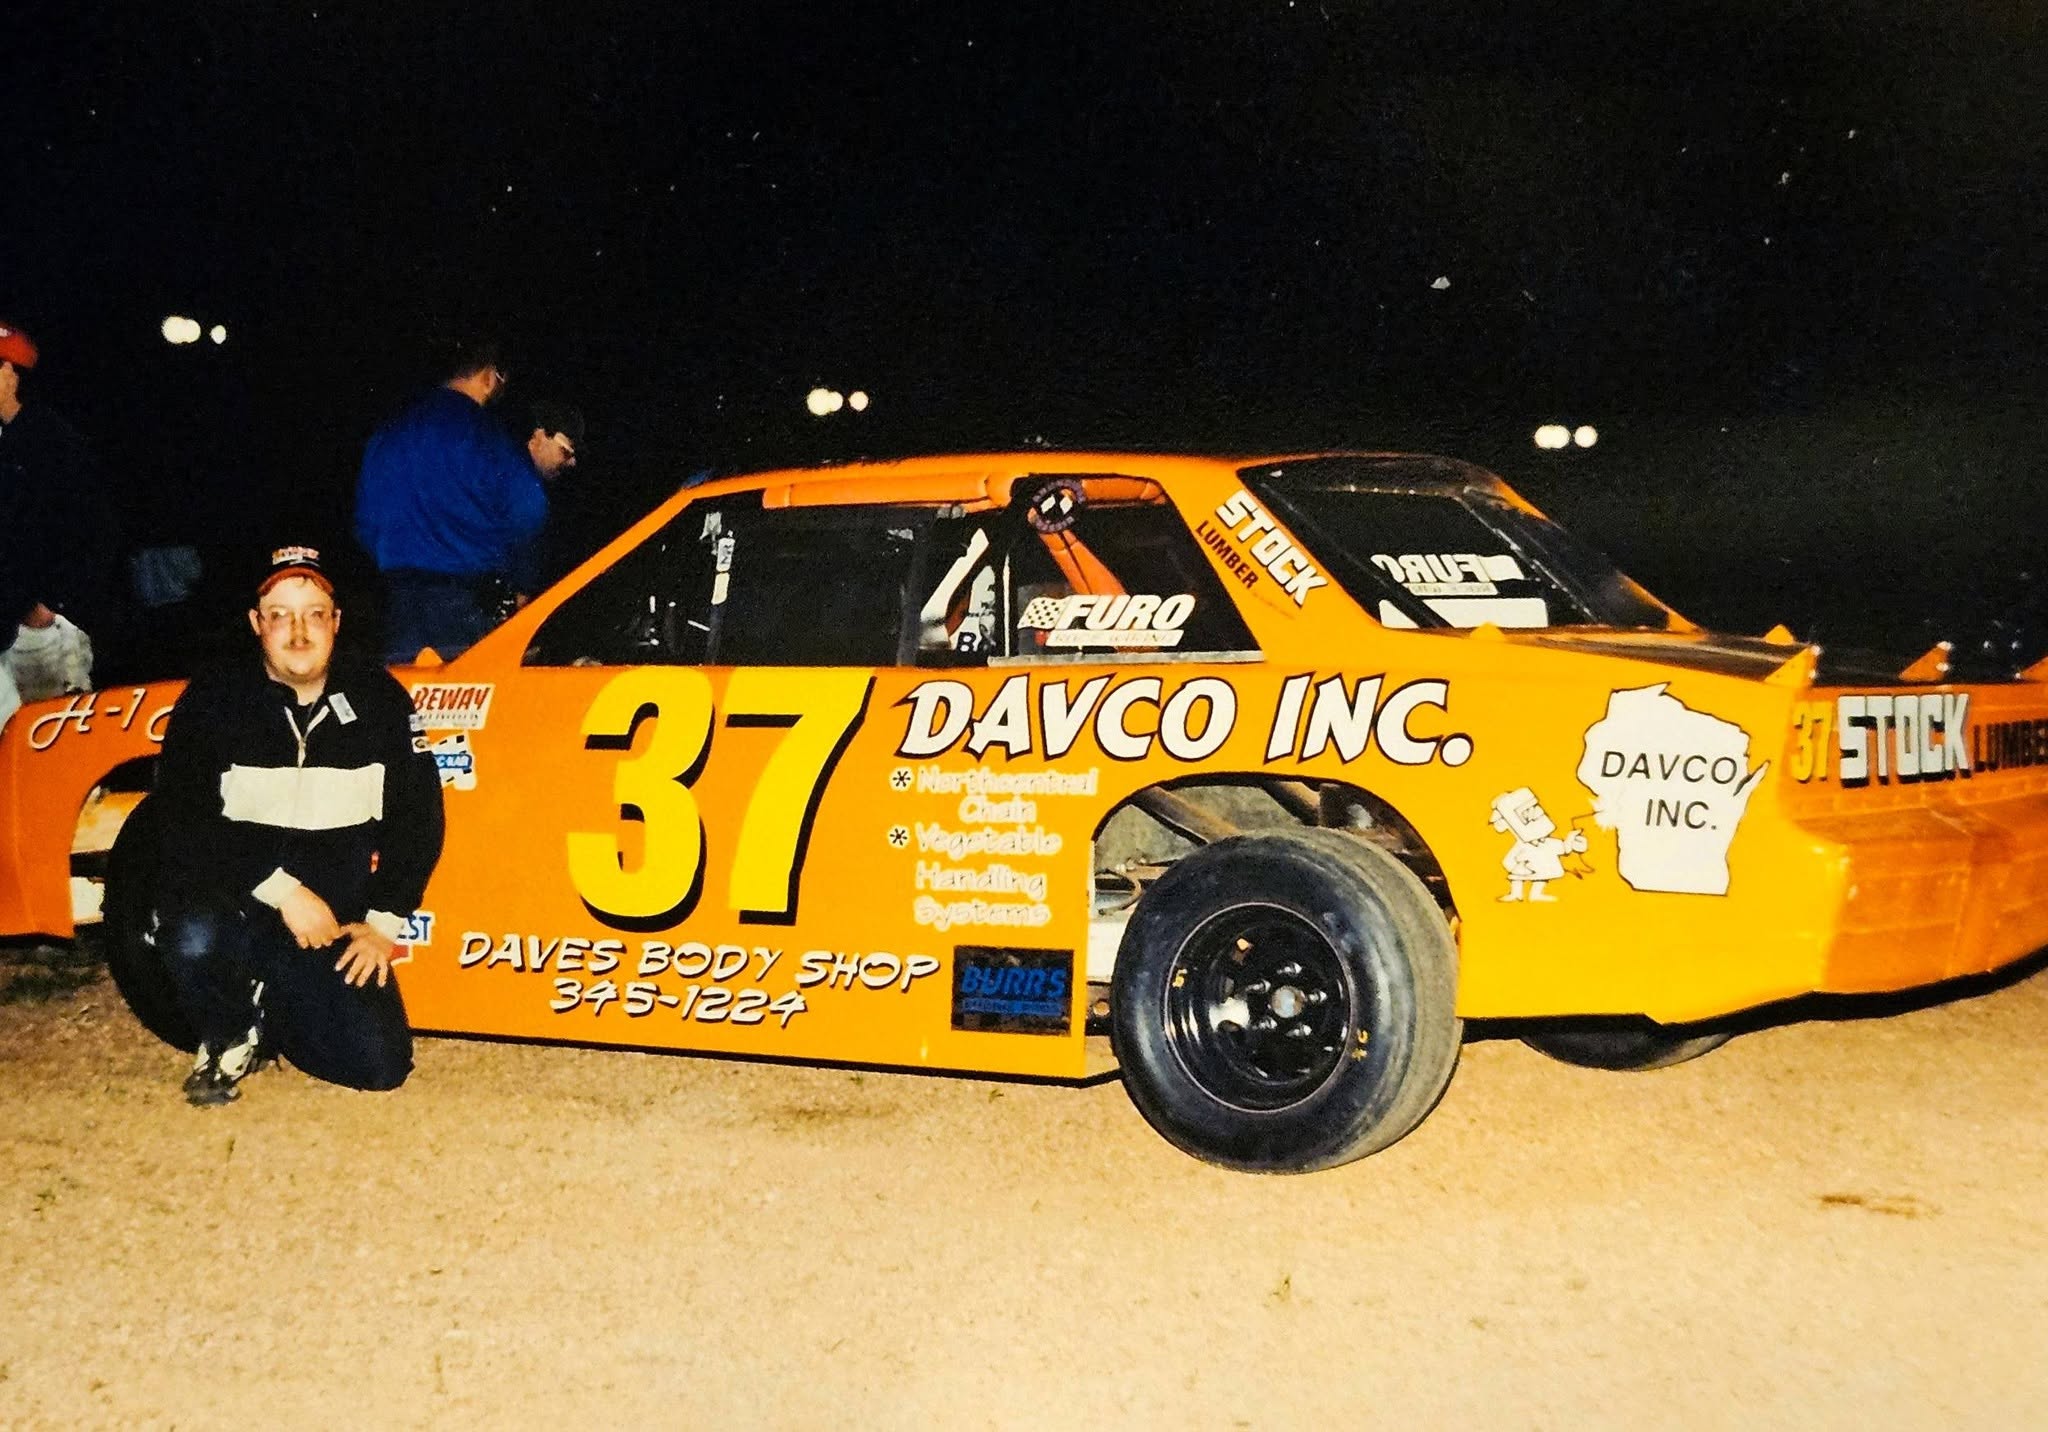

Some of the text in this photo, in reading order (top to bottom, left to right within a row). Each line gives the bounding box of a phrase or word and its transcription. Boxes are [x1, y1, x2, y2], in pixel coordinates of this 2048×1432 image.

[1196, 520, 1259, 589] LUMBER
[1215, 489, 1328, 609] STOCK
[1054, 594, 1196, 630] FURO
[891, 671, 1474, 766] DAVCO INC.
[1791, 693, 2048, 788] 37 STOCK LUMBE
[1600, 750, 1738, 785] DAVCO
[566, 665, 877, 932] 37
[1645, 799, 1717, 830] INC.
[914, 821, 1062, 861] Vegetable
[915, 860, 1047, 901] Handling
[913, 895, 1051, 931] Systems
[458, 932, 941, 993] DAVES BODY SHOP
[550, 977, 807, 1029] 345-1224
